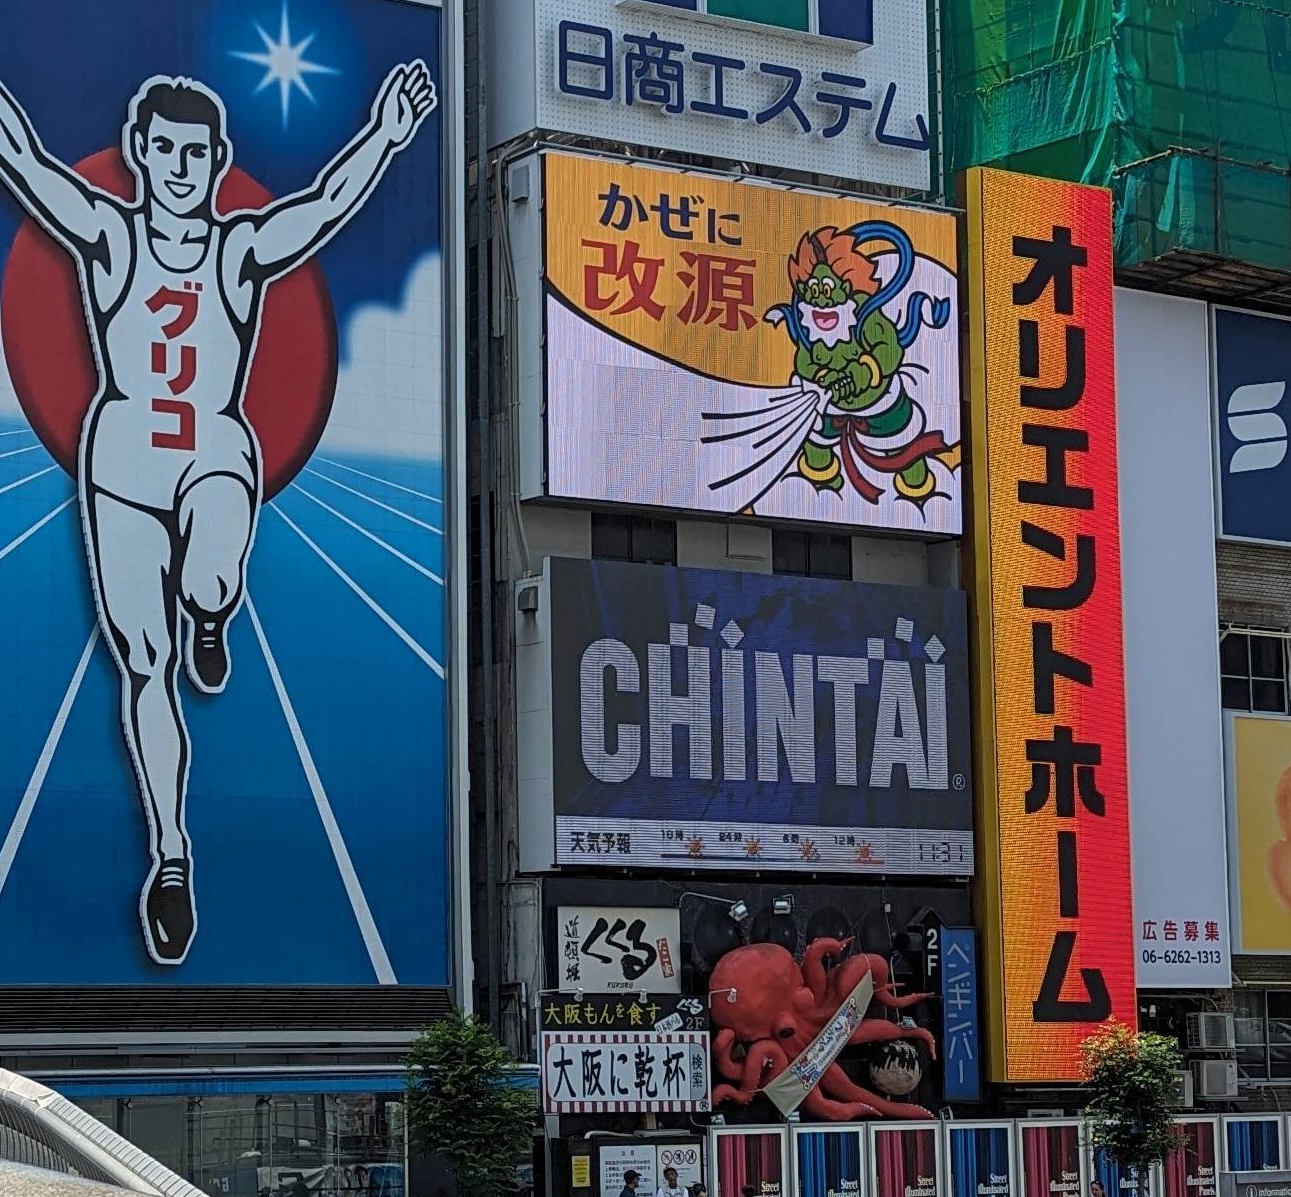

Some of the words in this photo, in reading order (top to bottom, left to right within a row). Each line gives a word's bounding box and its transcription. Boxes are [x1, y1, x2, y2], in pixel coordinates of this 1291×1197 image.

[557, 18, 931, 151] 日商エステム
[597, 182, 742, 246] かぜに
[581, 238, 759, 331] 改源
[144, 280, 204, 451] グリコ
[1012, 224, 1112, 1023] オリエントホーム
[579, 602, 949, 790] CHINTAI
[570, 831, 632, 855] 天気予報
[564, 914, 581, 983] 道頓堀
[581, 917, 658, 981] くくる
[1142, 919, 1221, 942] 広告募集
[1142, 949, 1221, 964] 06-6262-1313
[544, 1002, 662, 1026] 大阪もんを食す
[685, 1016, 706, 1031] 2F
[946, 942, 974, 1084] ペンギンバー
[552, 1045, 686, 1099] 大阪に乾杯
[691, 1053, 704, 1089] 検索
